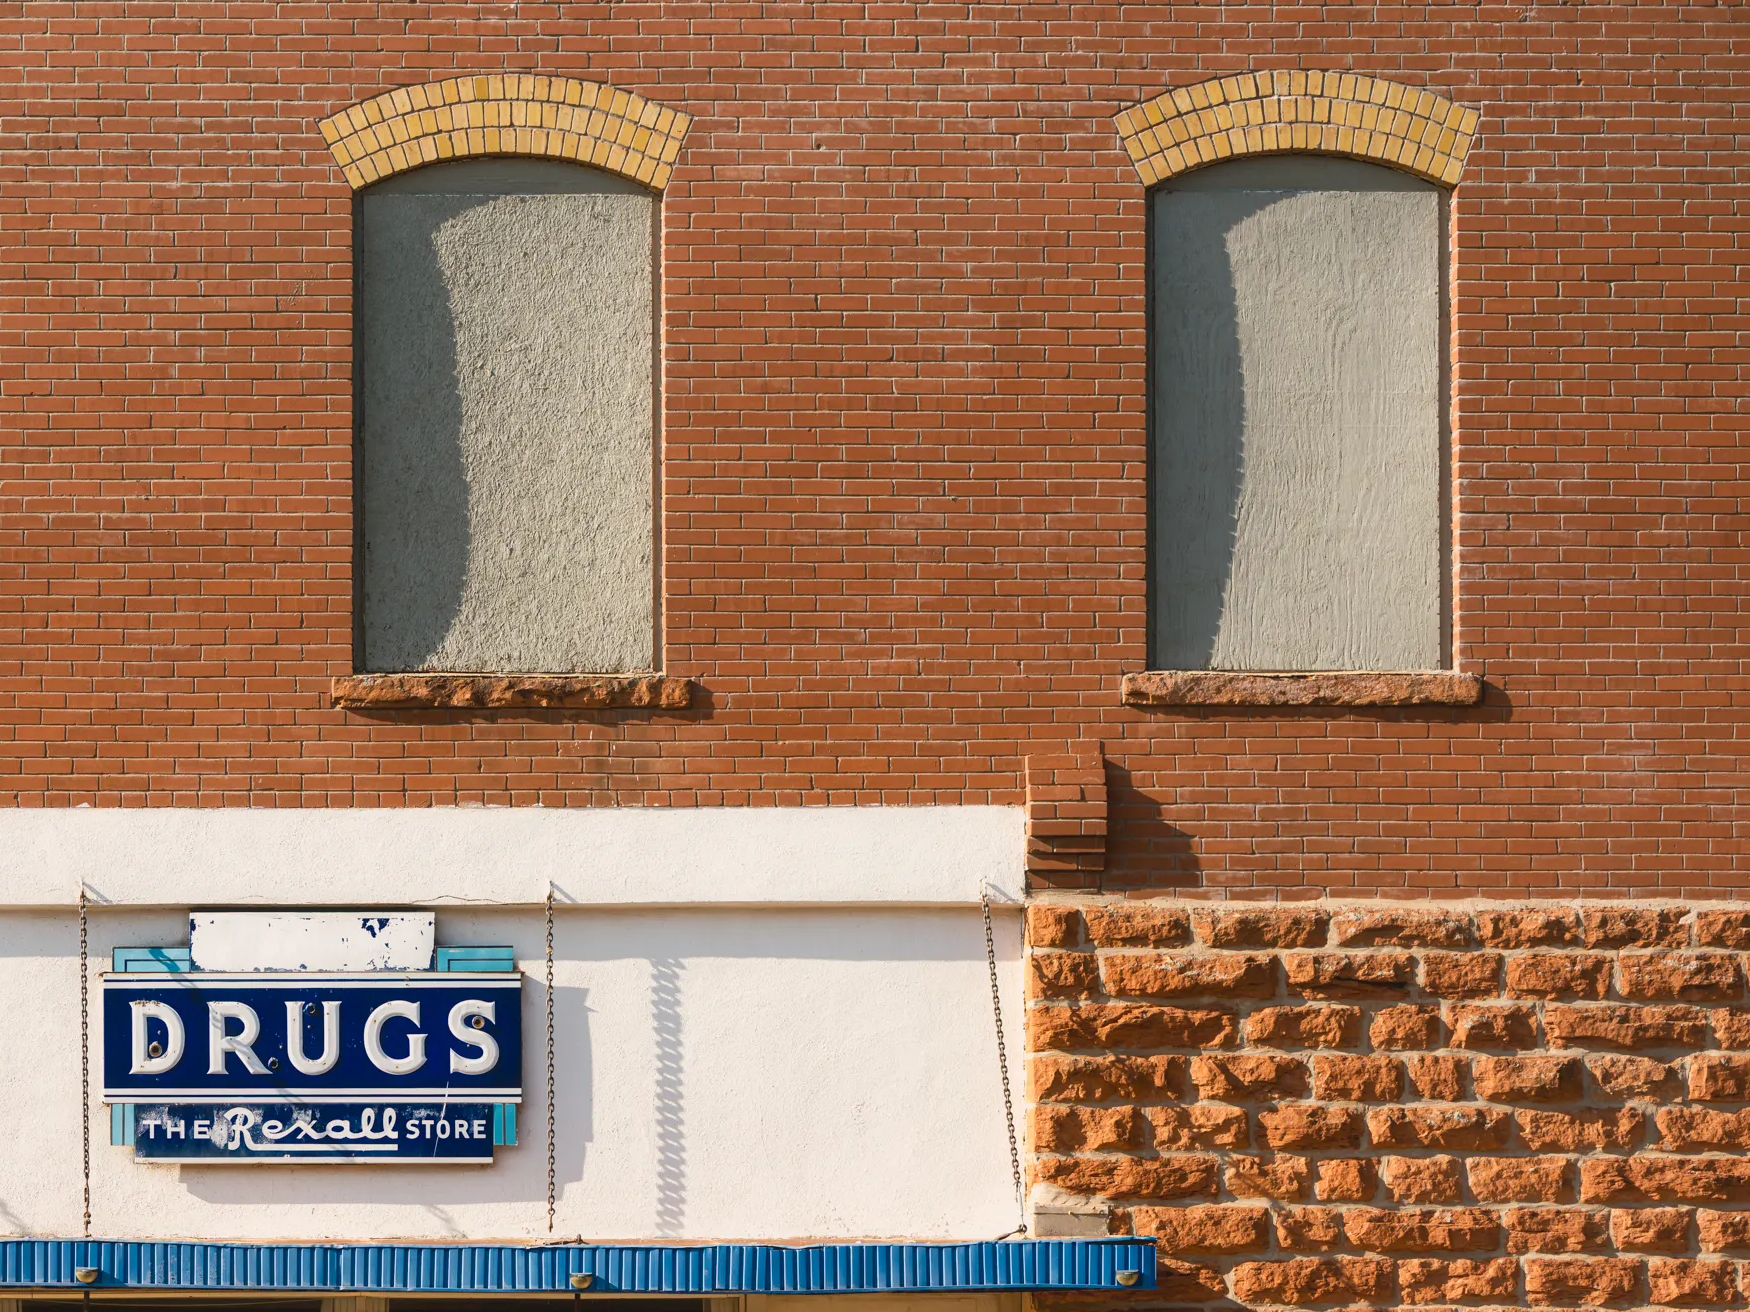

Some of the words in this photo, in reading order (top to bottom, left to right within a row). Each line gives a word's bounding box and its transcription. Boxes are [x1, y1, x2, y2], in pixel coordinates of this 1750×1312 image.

[128, 1000, 500, 1075] DRUGS
[143, 1119, 210, 1140] THE
[223, 1107, 398, 1151] Rexall
[405, 1119, 487, 1140] STORE
